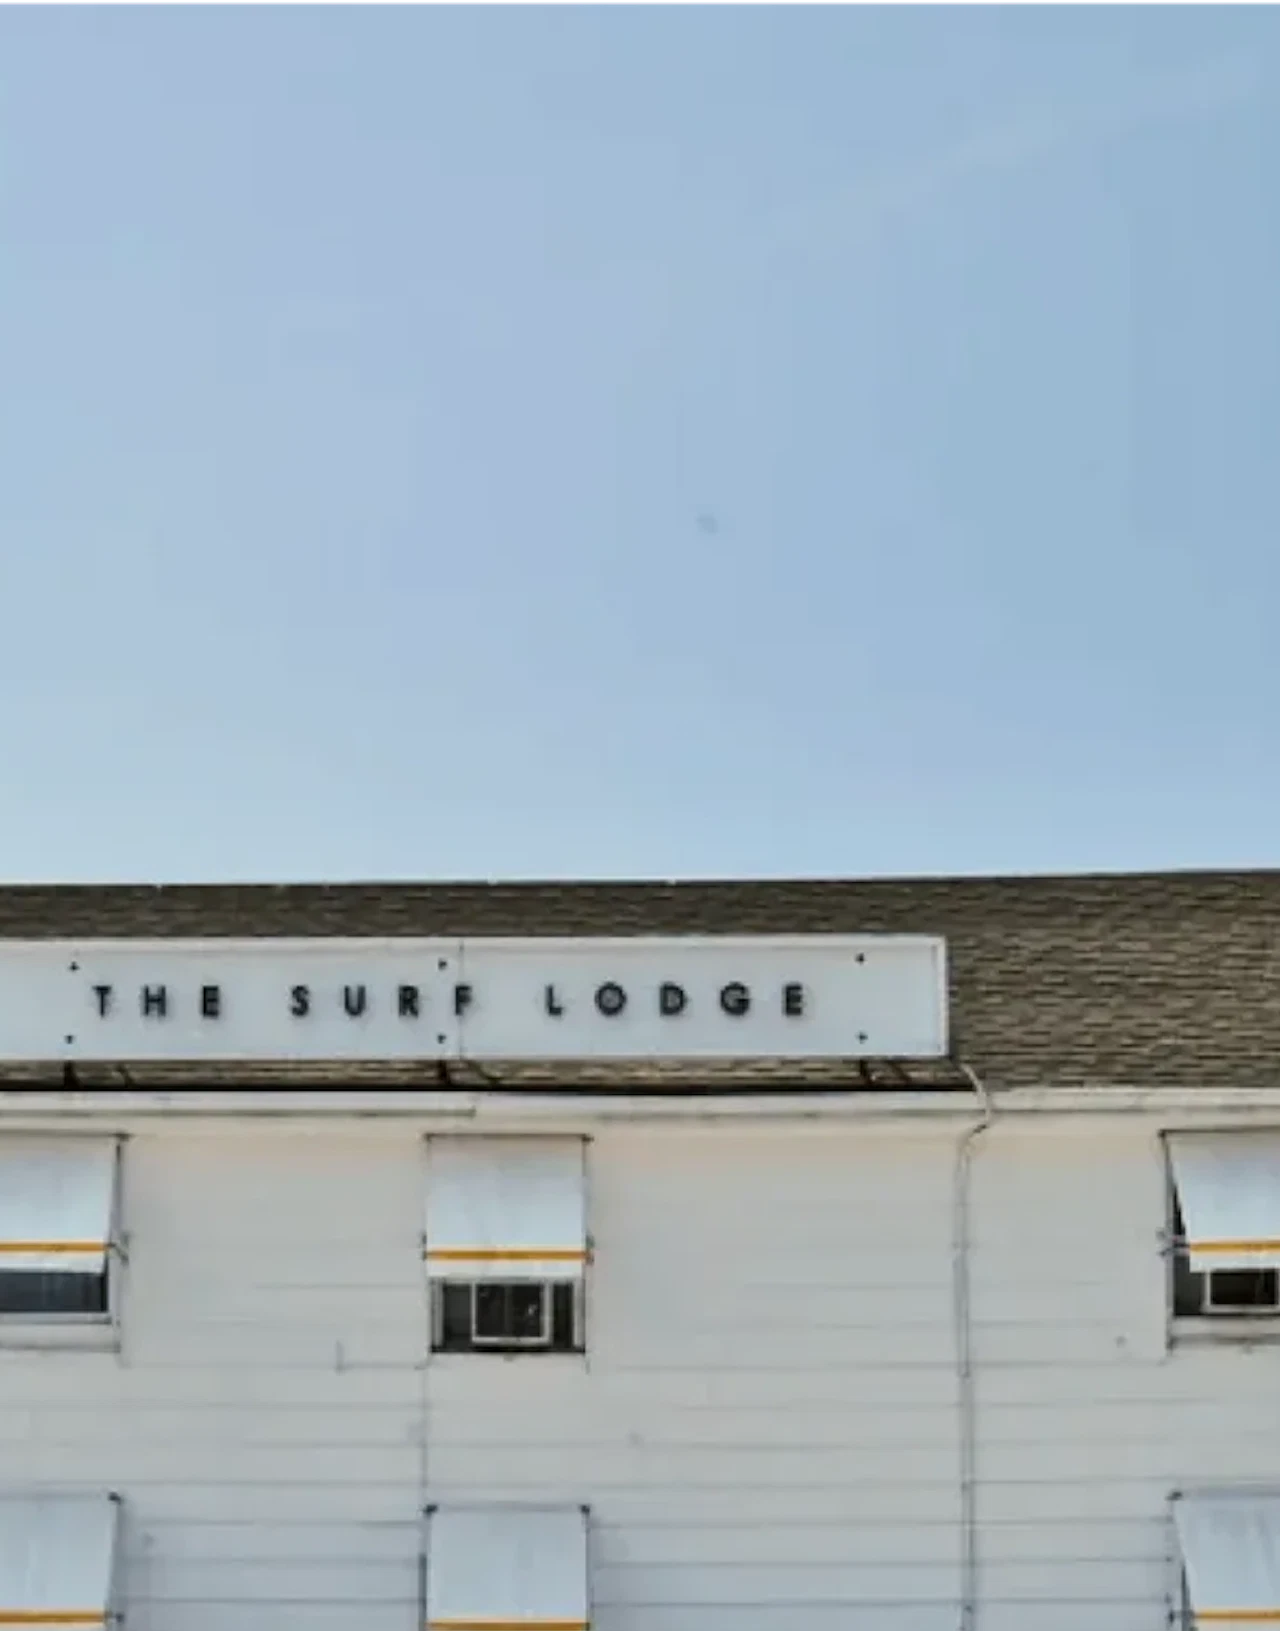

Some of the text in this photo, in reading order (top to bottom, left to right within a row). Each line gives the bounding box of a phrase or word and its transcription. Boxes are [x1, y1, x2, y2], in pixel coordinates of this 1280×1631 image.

[91, 982, 803, 1018] THE SURF LODGE
